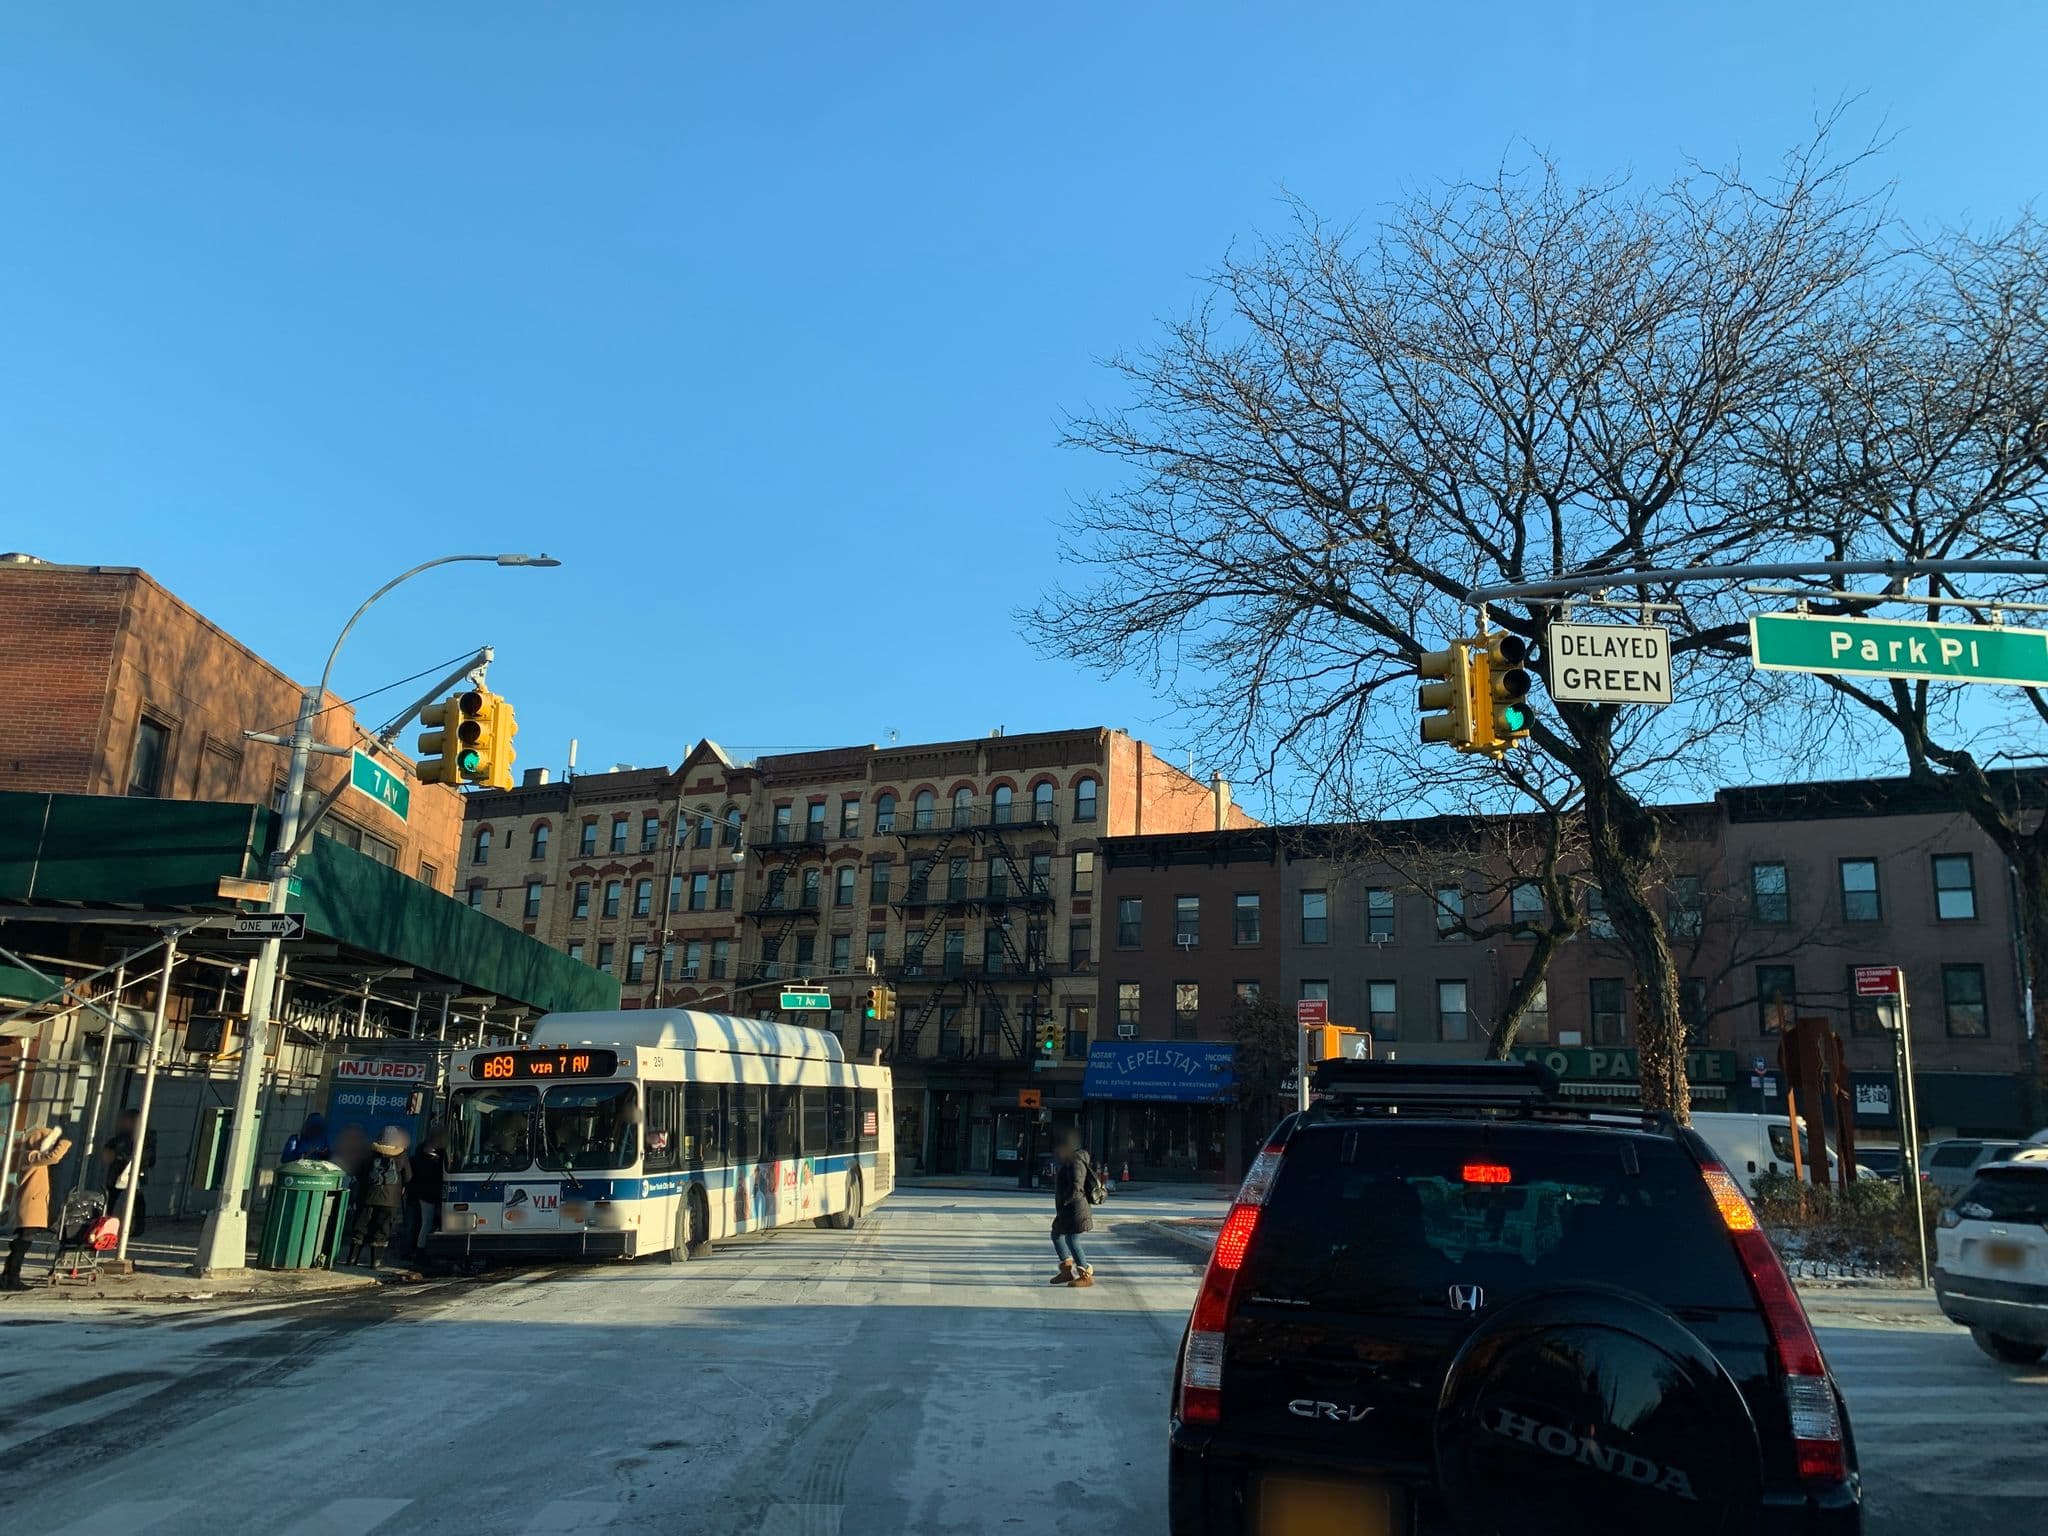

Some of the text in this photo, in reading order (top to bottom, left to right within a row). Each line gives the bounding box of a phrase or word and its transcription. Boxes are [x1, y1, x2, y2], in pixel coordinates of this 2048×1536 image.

[1561, 634, 1658, 659] DELAYED
[1829, 630, 1979, 667] Park Pl
[1563, 668, 1661, 692] GREEN
[374, 769, 382, 793] 7
[240, 920, 293, 932] ONE WAY
[796, 996, 802, 1006] 7
[484, 1056, 590, 1078] B69 VIA 7 AV
[1090, 1052, 1116, 1060] NOTARY
[1090, 1061, 1113, 1070] PUBLIC
[1117, 1049, 1200, 1076] LEPELSTAT
[1205, 1053, 1232, 1062] INCOME
[340, 1061, 425, 1078] INJURED?
[338, 1093, 365, 1106] (800)
[1288, 1399, 1375, 1422] CR-V
[1494, 1408, 1700, 1503] HONDA
